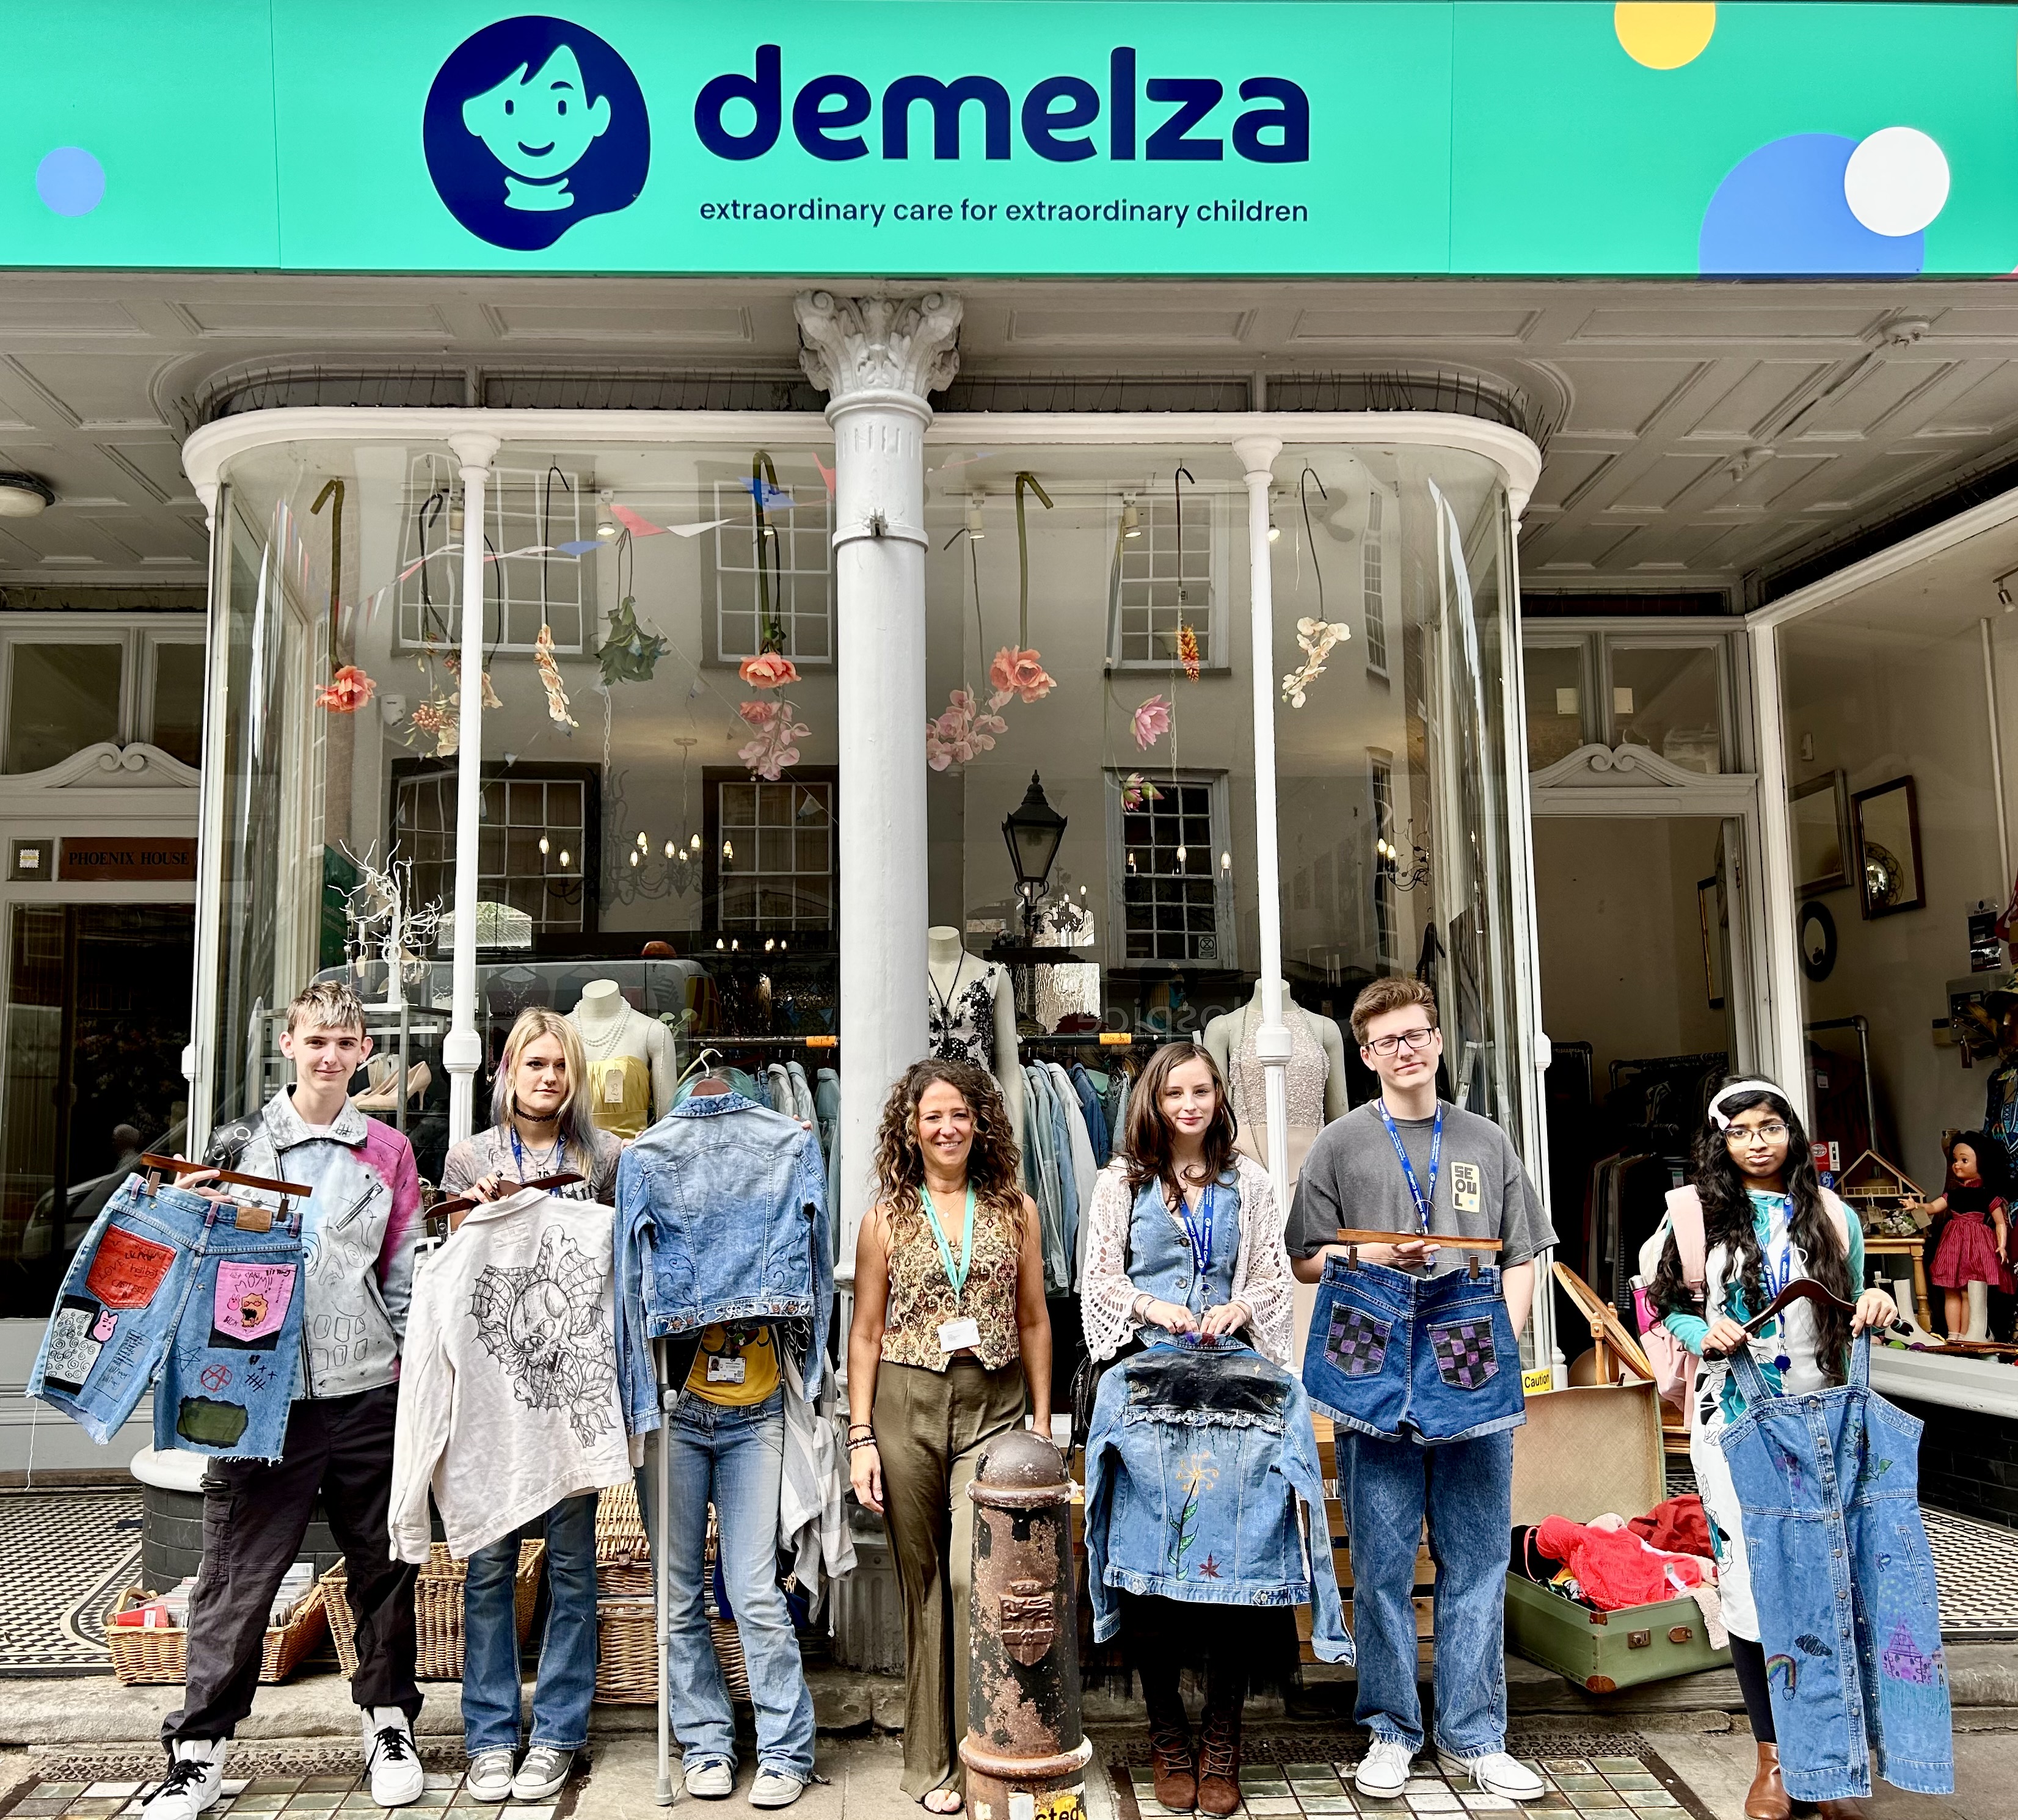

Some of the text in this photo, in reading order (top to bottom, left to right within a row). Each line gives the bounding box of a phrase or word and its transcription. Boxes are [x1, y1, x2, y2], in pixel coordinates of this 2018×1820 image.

[694, 45, 1309, 163] demelza
[701, 198, 1307, 228] extraordinary care for extraordinary children
[69, 852, 190, 865] PHOENIX HOUSE
[98, 1258, 125, 1280] LOVE
[1524, 1373, 1550, 1388] Caution
